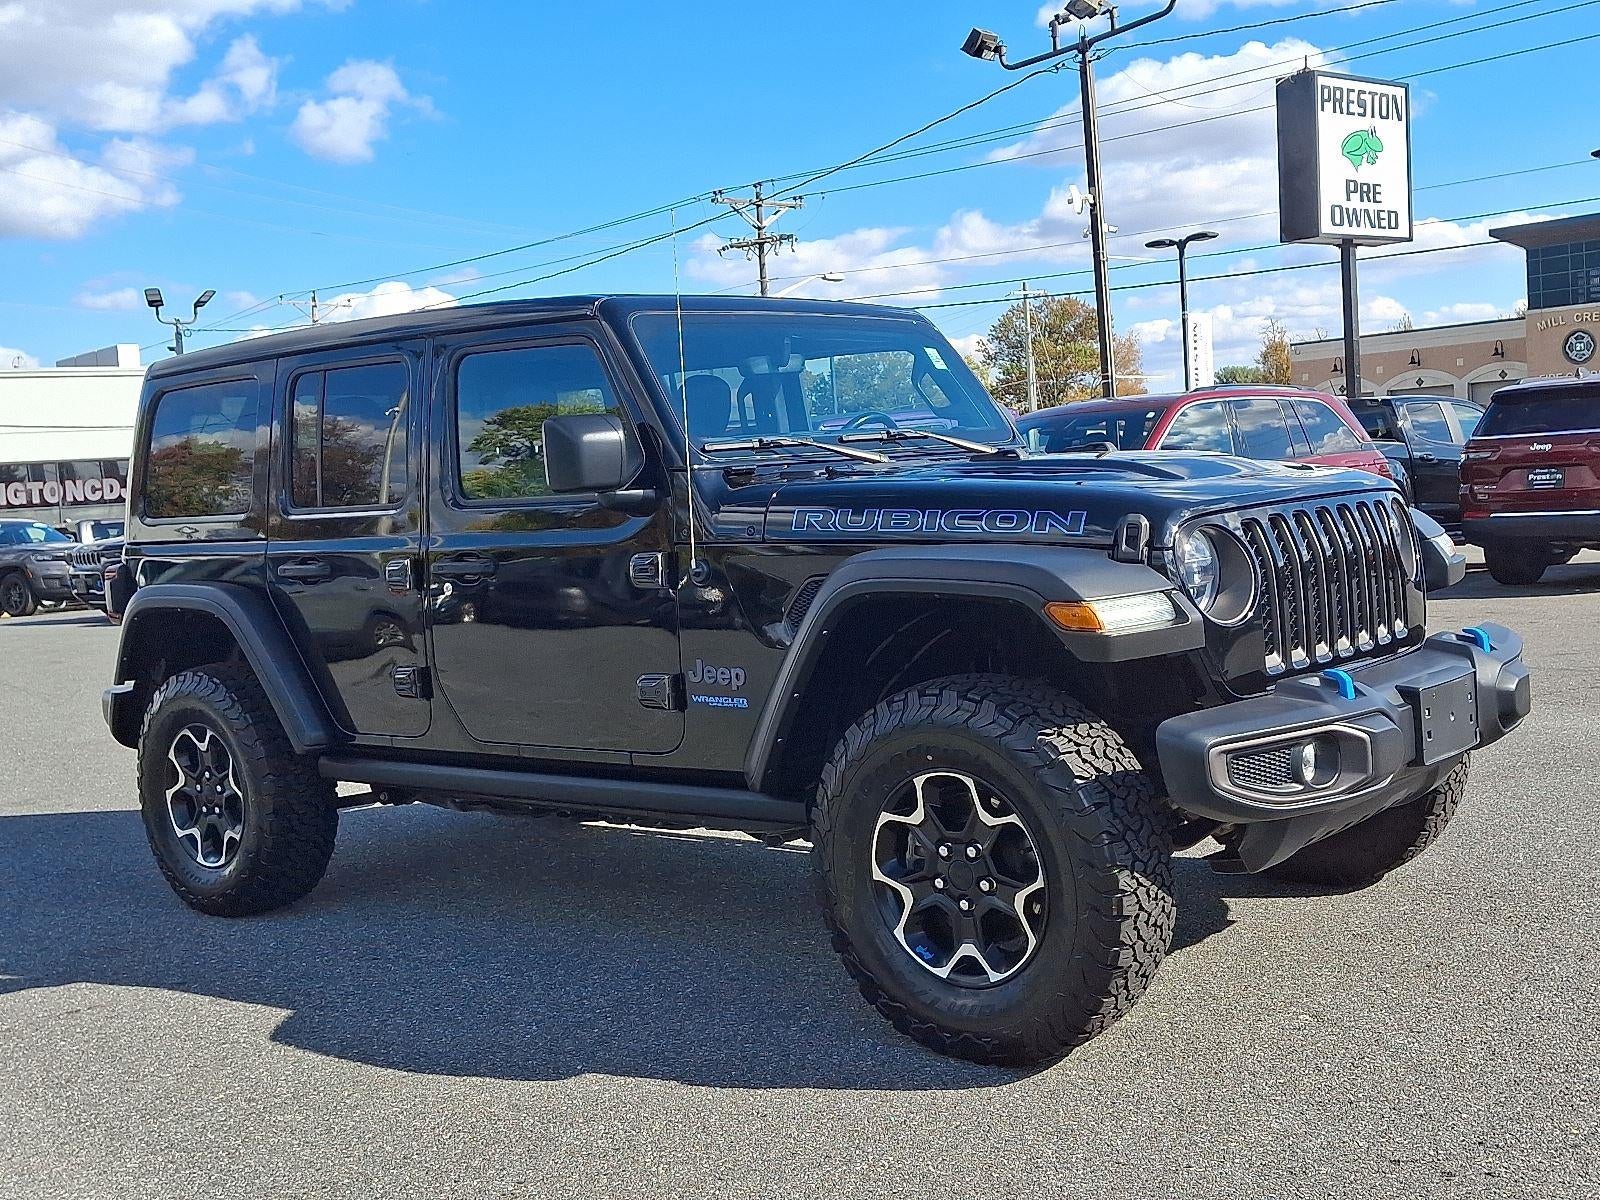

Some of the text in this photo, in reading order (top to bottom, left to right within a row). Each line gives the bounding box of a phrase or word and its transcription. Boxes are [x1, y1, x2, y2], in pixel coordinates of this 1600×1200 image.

[1320, 84, 1403, 122] PRESTON
[1345, 178, 1382, 204] PRE
[1330, 204, 1399, 230] OWNED
[1536, 315, 1567, 332] MILL
[1575, 342, 1585, 352] 21
[1529, 442, 1553, 453] Jeep
[791, 507, 1087, 535] RUBICON
[687, 658, 746, 691] Jeep
[691, 694, 748, 705] WRANGLER
